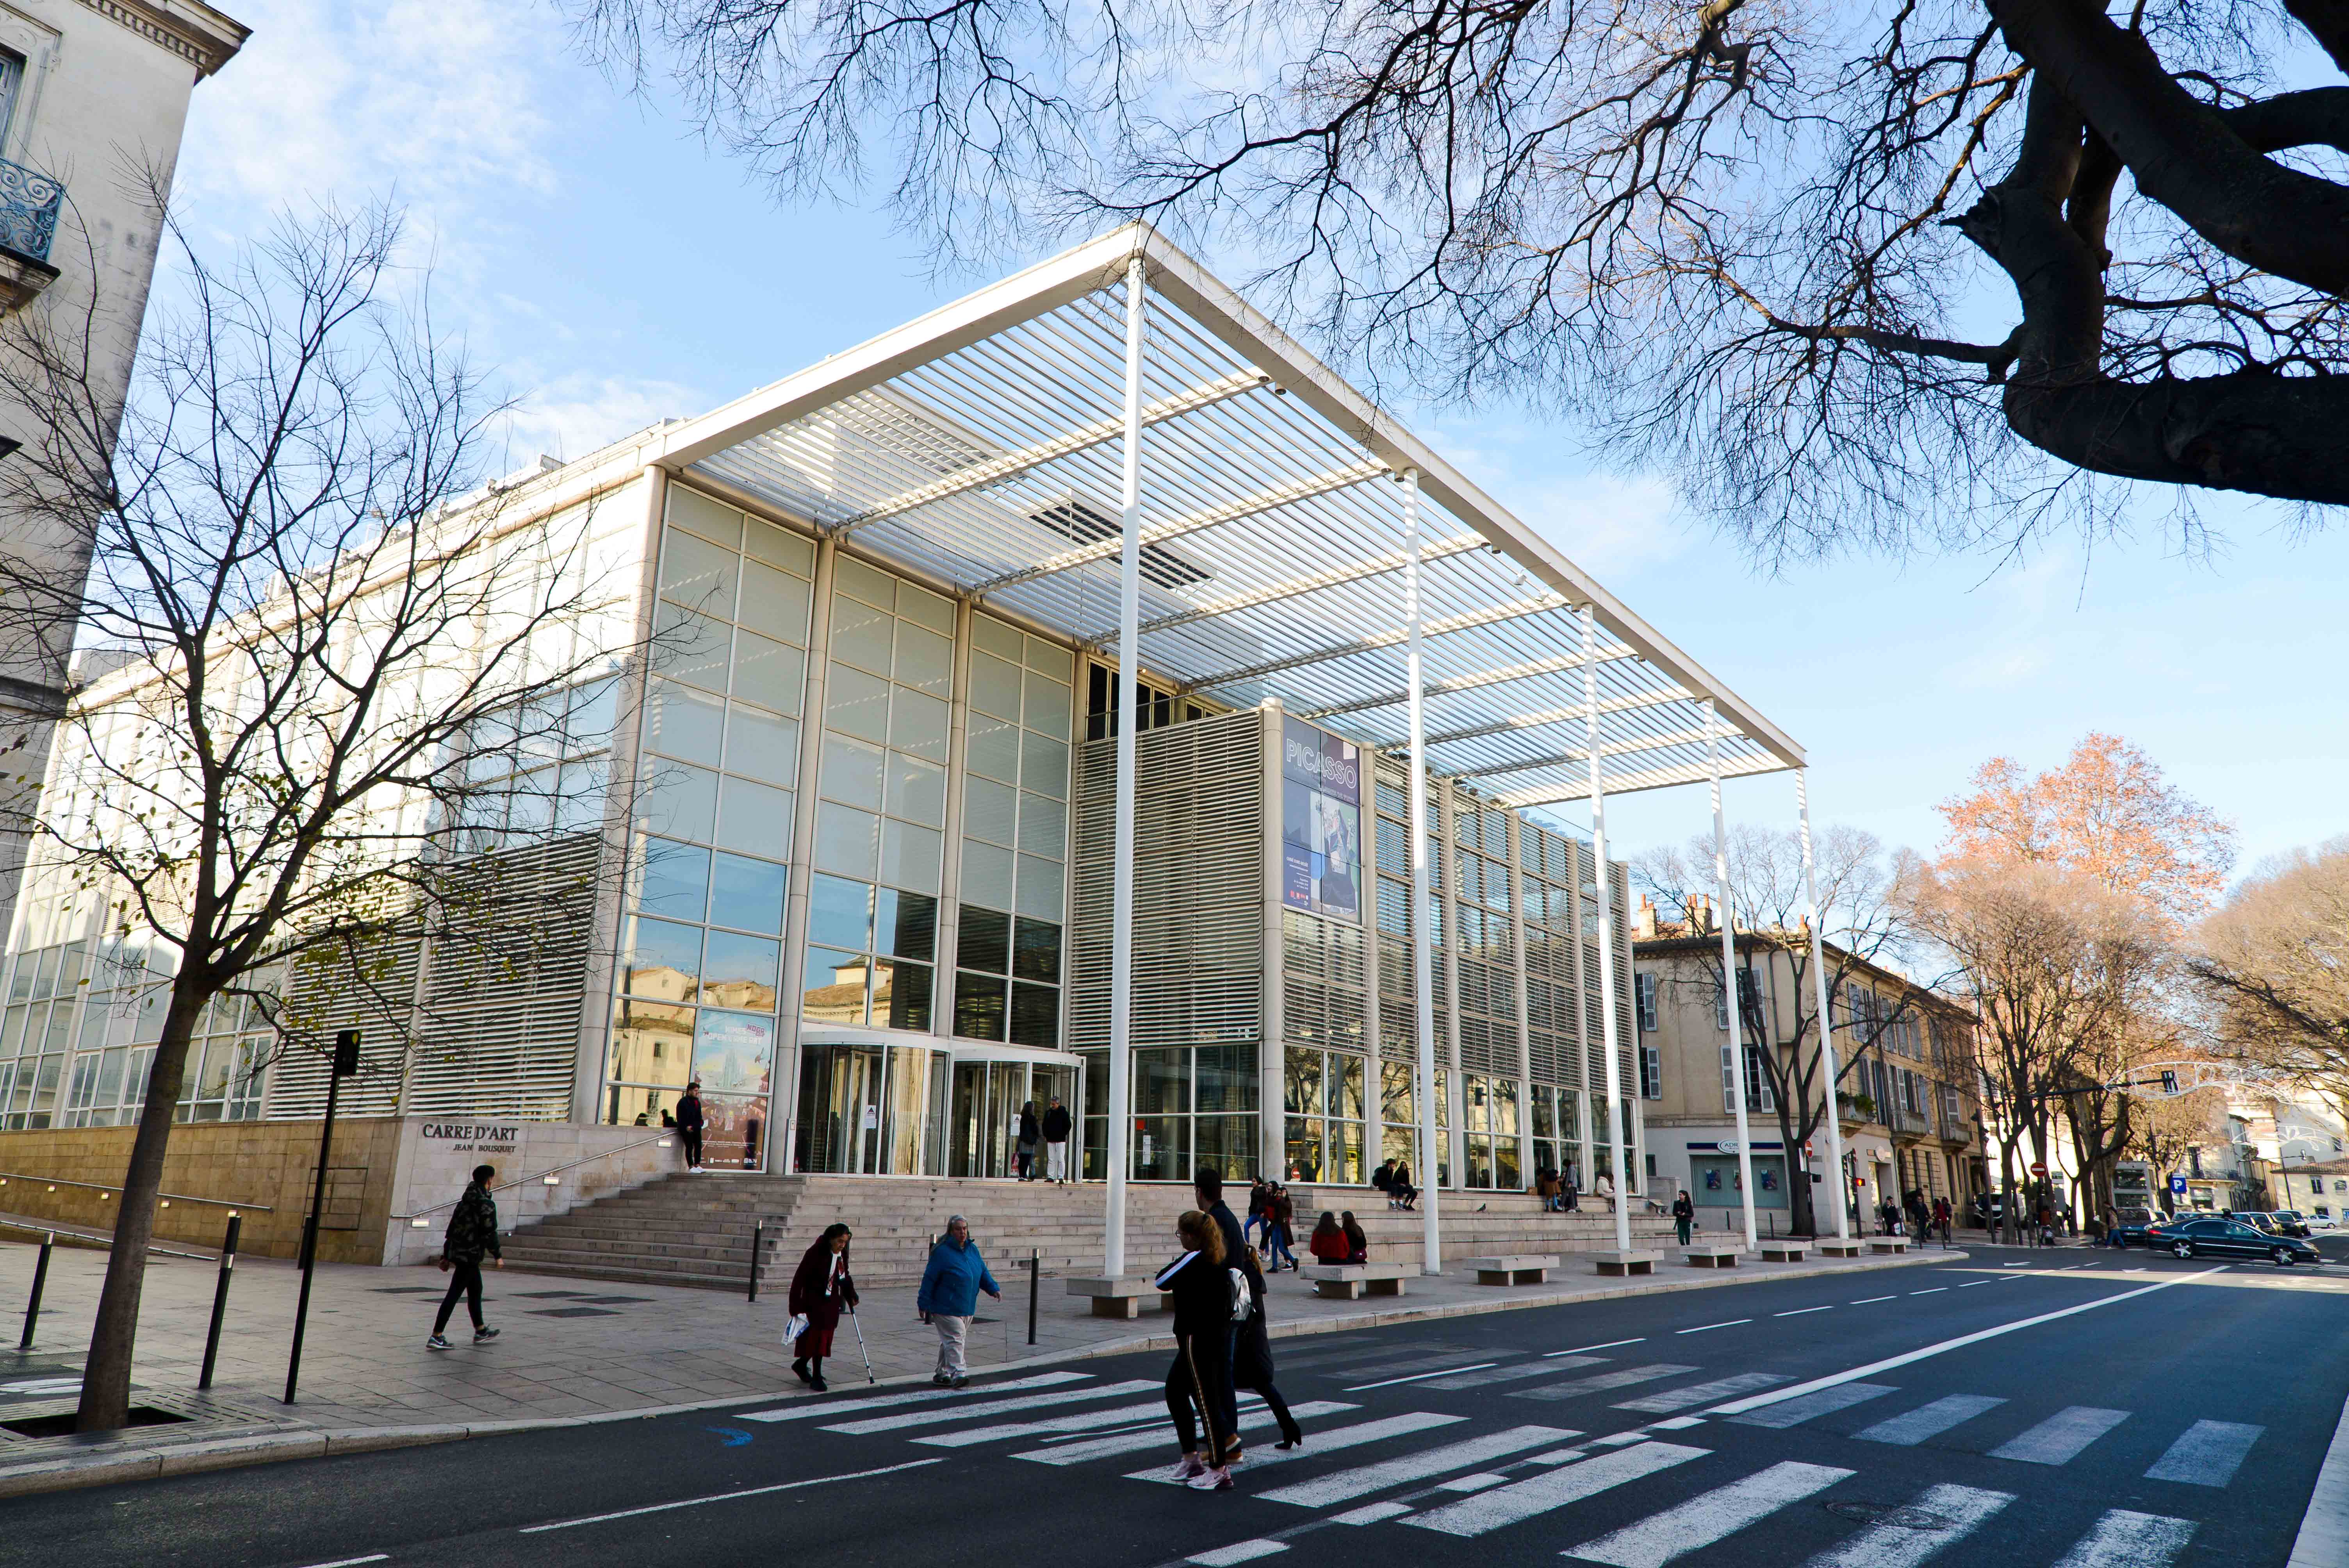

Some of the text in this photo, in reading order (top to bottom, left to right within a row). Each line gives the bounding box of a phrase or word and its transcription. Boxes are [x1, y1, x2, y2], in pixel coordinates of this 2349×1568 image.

[1287, 738, 1356, 789] PICASSO
[423, 1124, 518, 1140] CARRE D'ART
[2173, 1180, 2183, 1190] P
